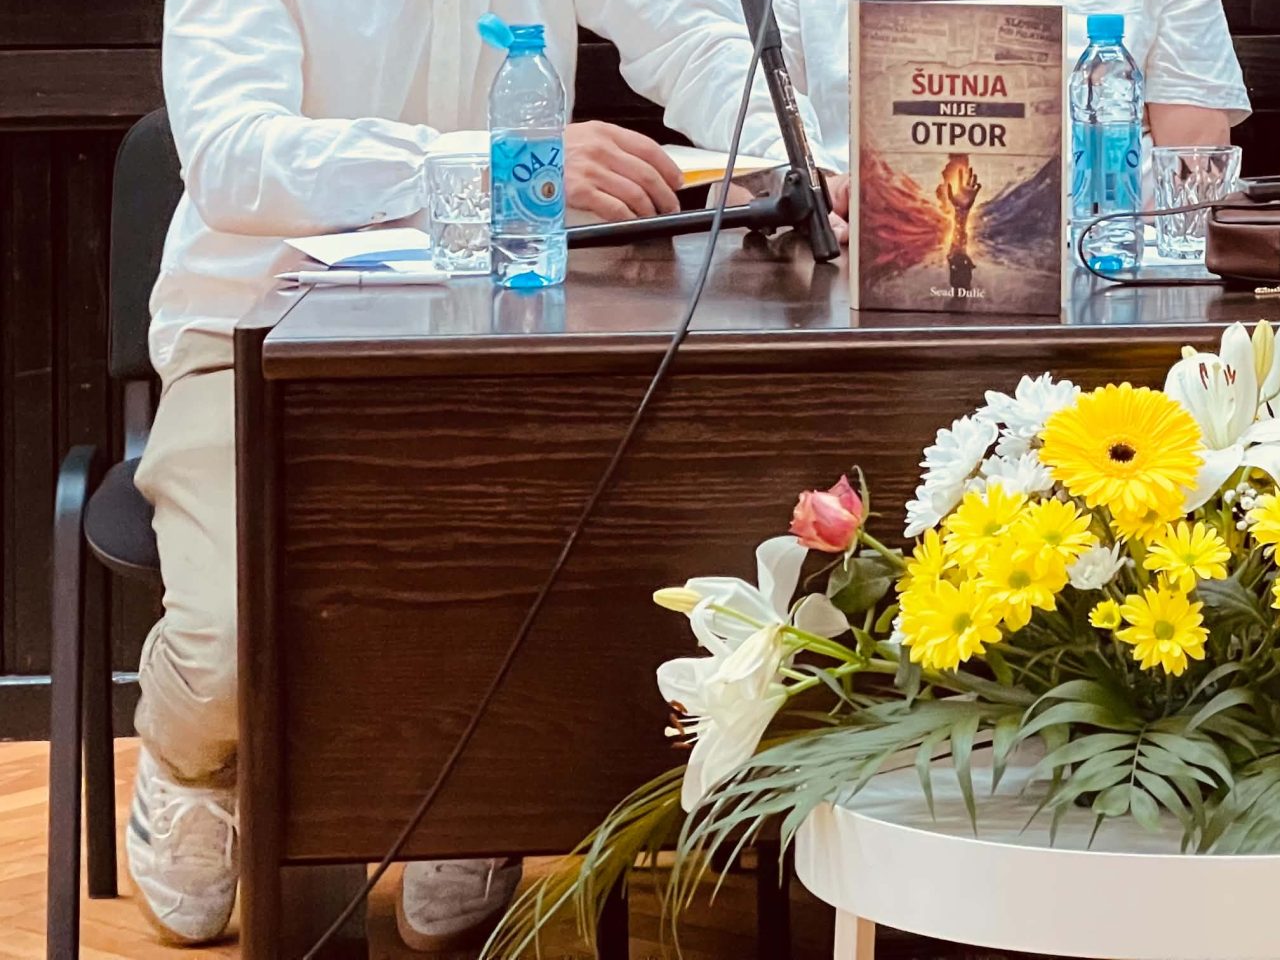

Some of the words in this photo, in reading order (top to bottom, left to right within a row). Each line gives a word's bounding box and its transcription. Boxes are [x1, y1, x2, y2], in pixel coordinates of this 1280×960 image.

[911, 68, 1008, 97] ŠUTNJA
[939, 102, 977, 116] NIJE
[911, 121, 1007, 147] OTPOR
[512, 147, 564, 182] OAZ
